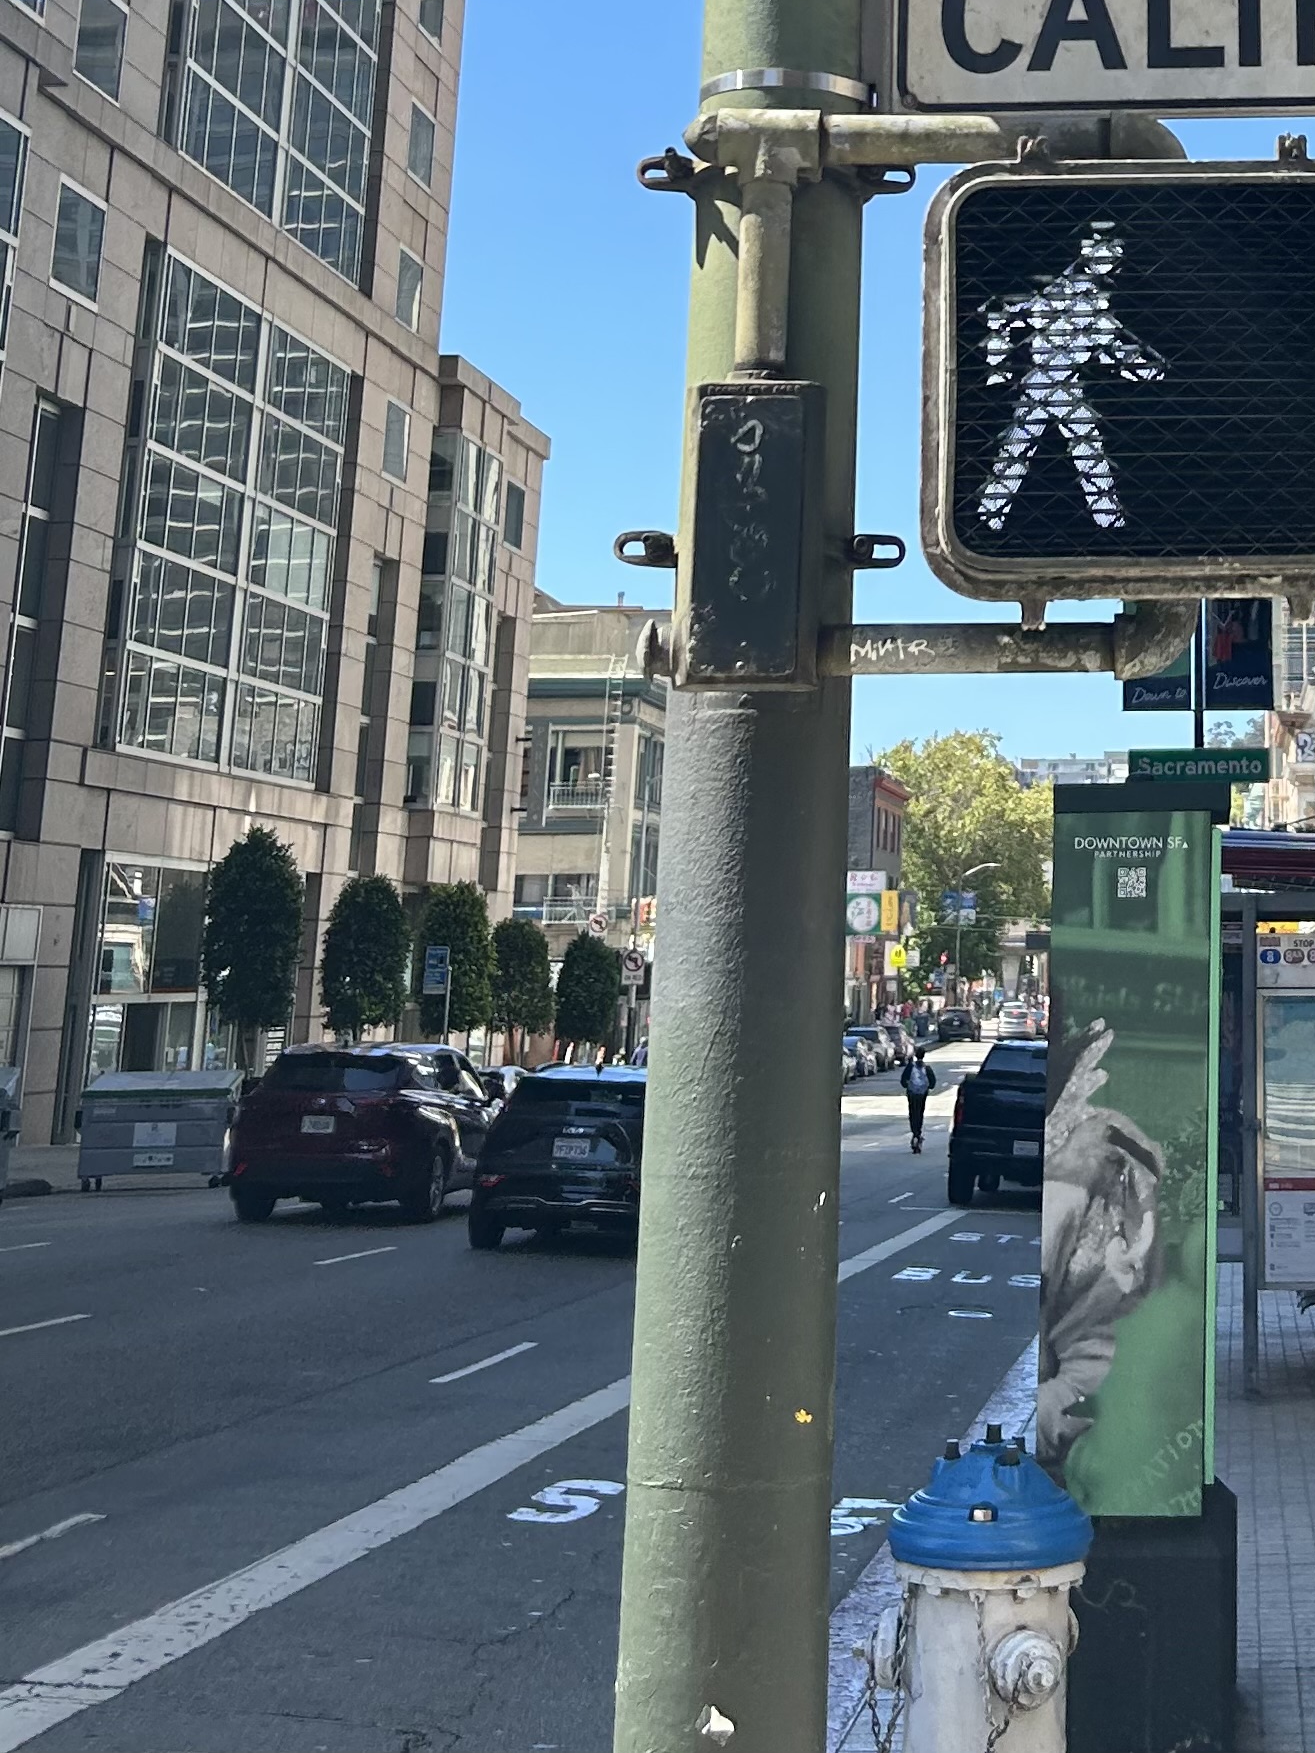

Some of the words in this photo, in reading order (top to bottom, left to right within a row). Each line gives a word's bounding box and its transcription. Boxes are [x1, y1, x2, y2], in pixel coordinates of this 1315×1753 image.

[1213, 672, 1268, 690] Discover
[1131, 686, 1172, 704] Down
[1137, 757, 1263, 775] Sacramento
[1074, 836, 1164, 850] DOWNTOWN
[1093, 850, 1162, 858] PARTNERSHIP
[1294, 939, 1315, 947] STOP
[1266, 950, 1275, 962] 8
[891, 1265, 1041, 1288] BUS
